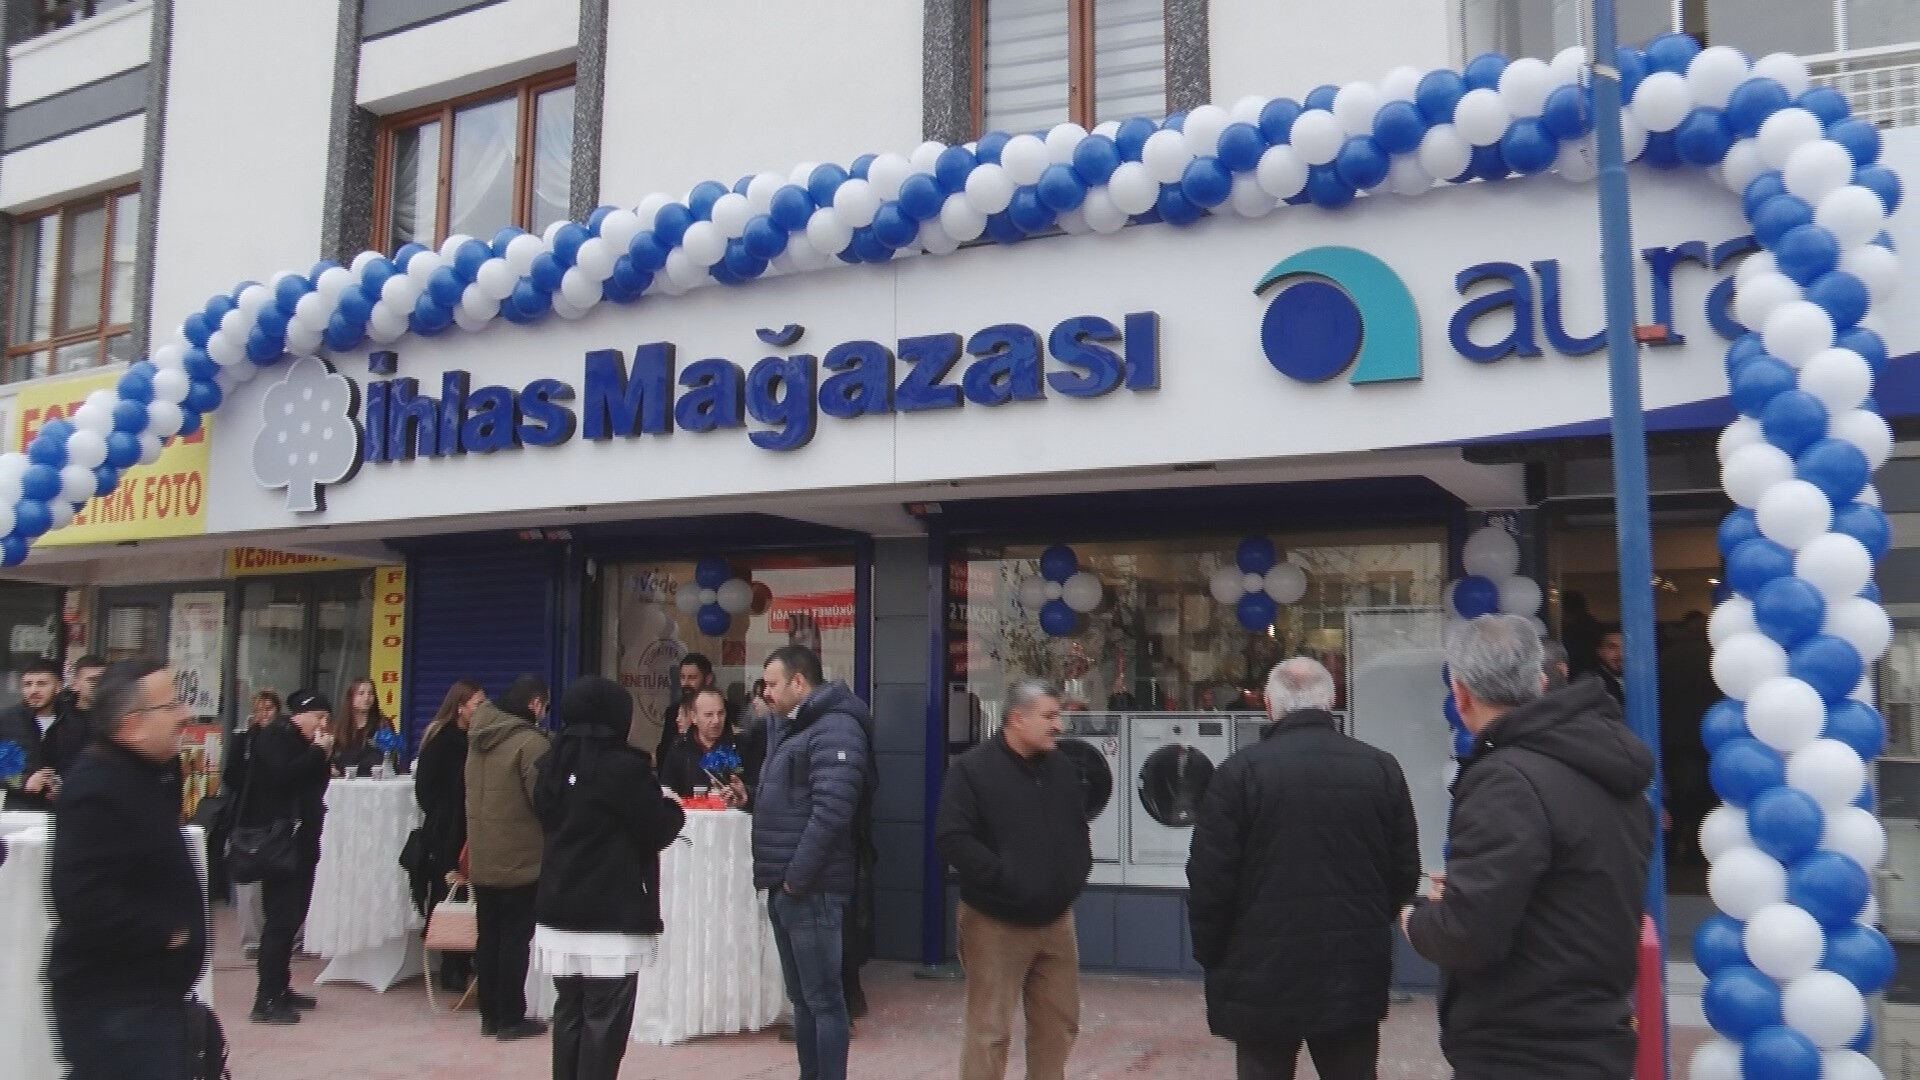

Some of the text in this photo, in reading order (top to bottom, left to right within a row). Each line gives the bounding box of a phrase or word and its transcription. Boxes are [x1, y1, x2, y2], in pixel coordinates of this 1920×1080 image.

[583, 311, 1161, 450] Mağazası
[143, 471, 202, 520] FOTO
[382, 570, 405, 649] FOTO
